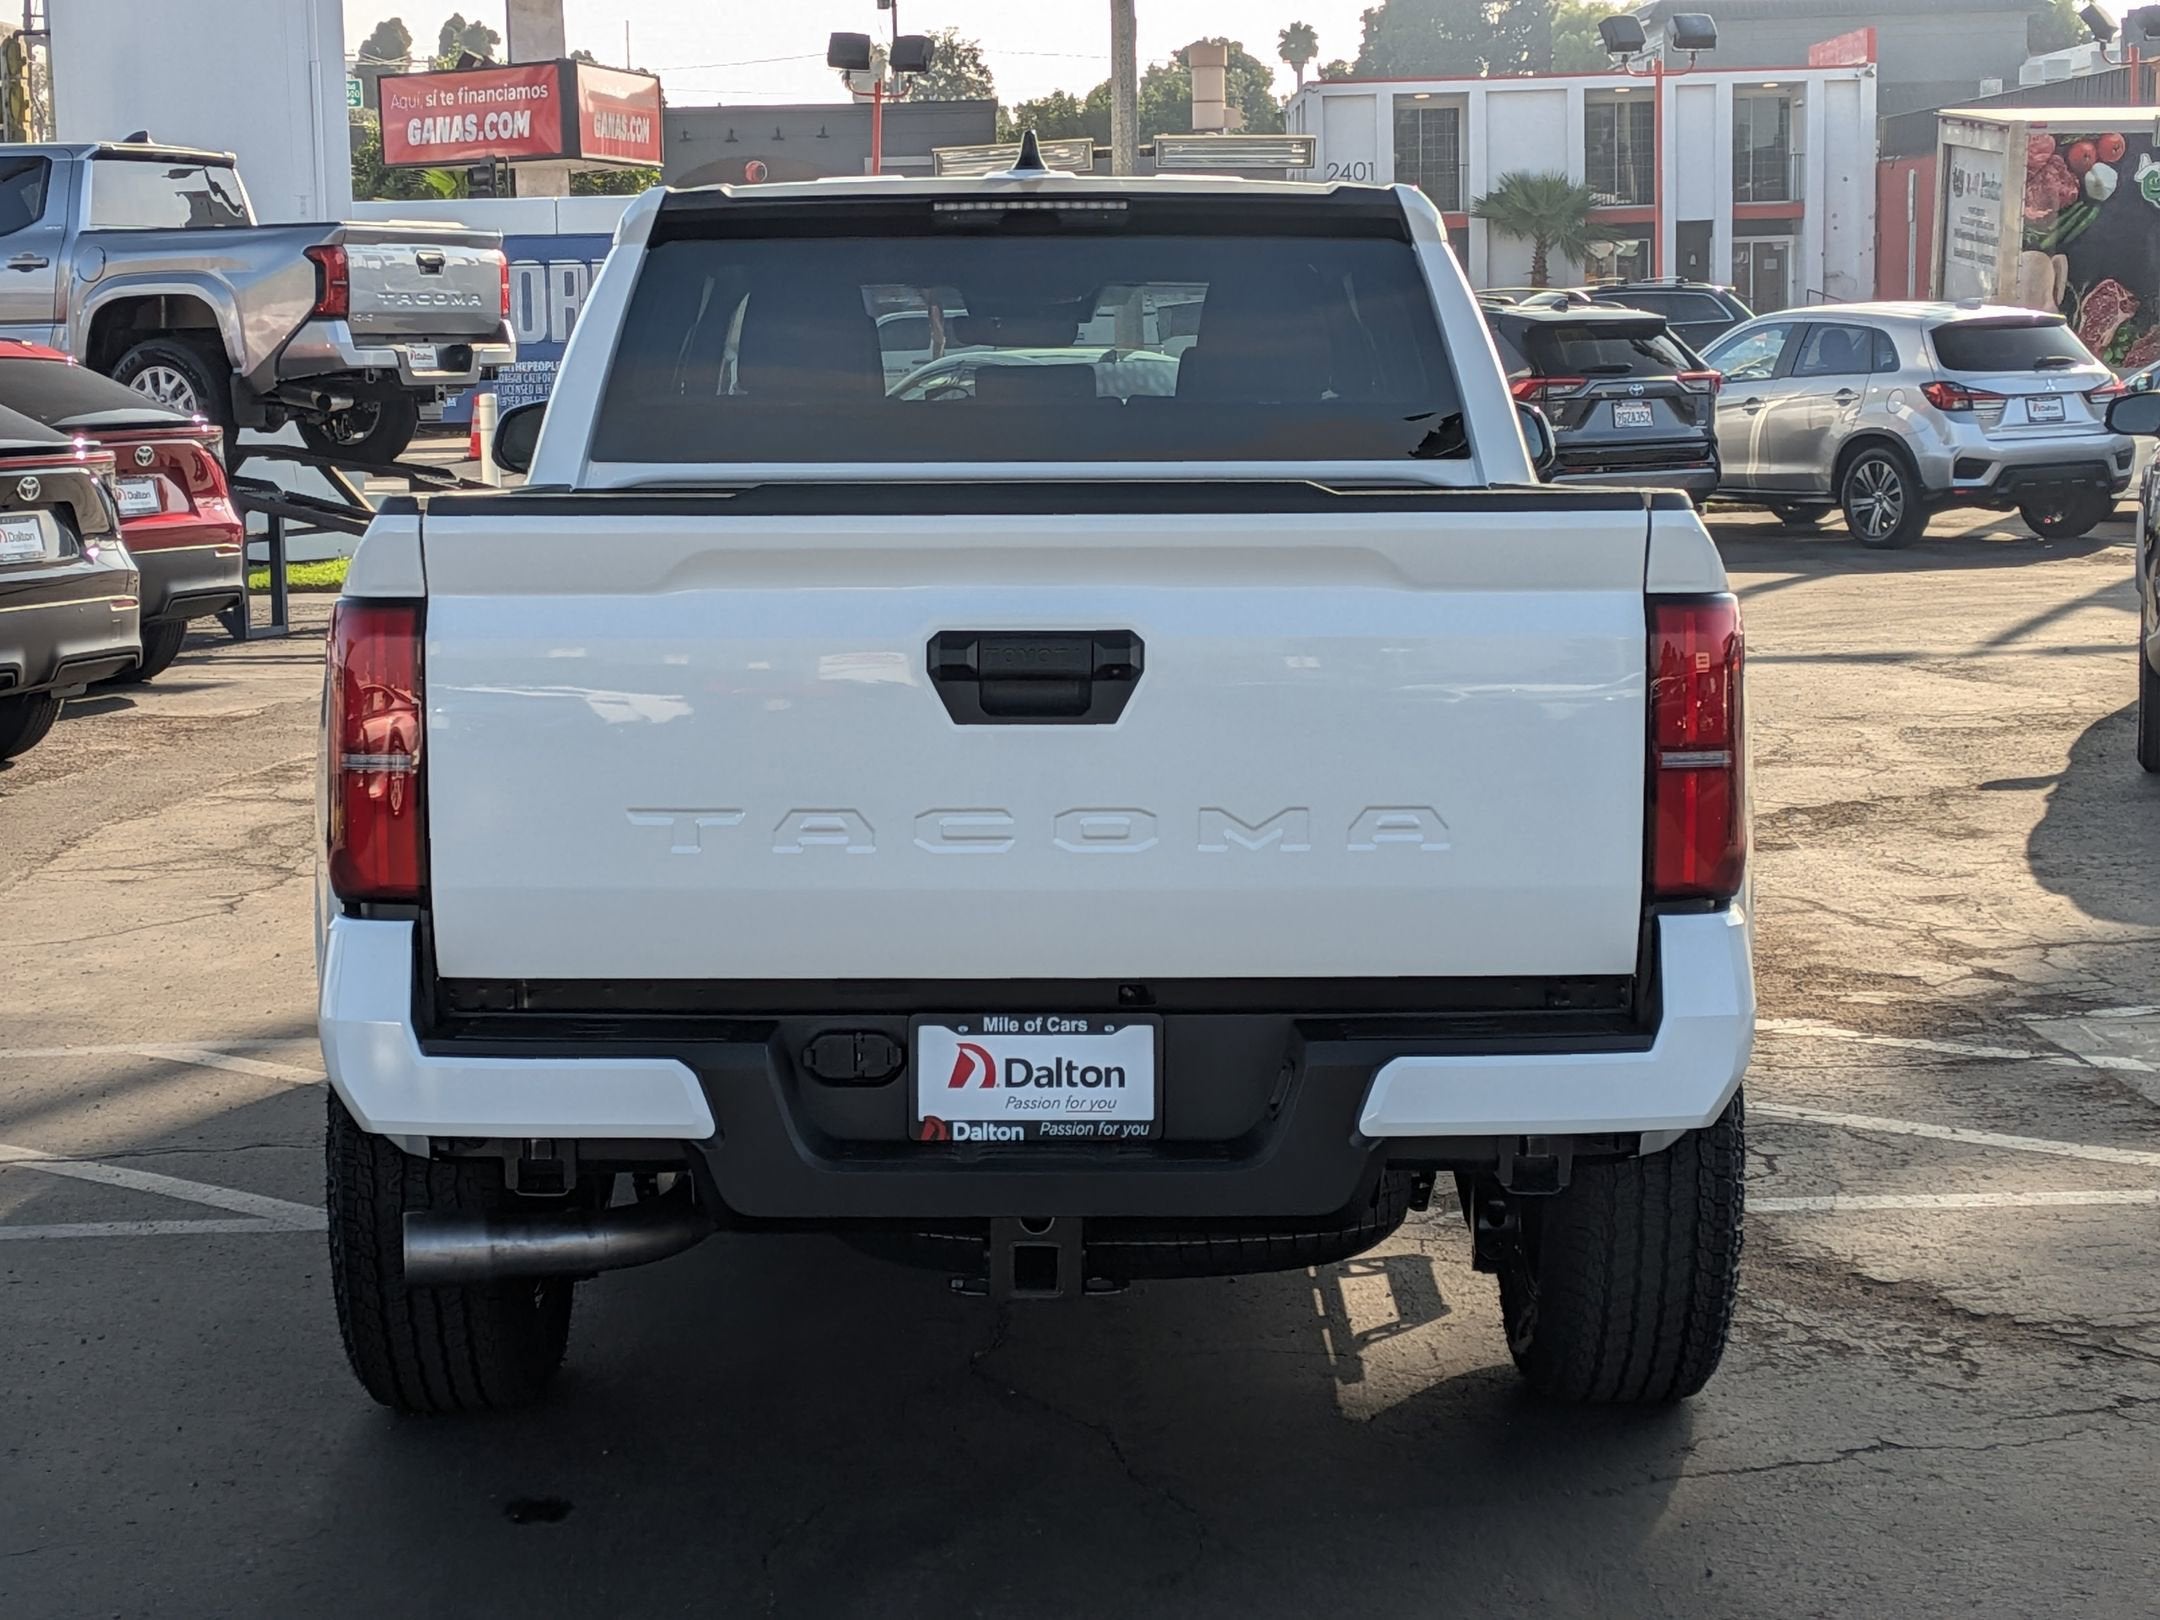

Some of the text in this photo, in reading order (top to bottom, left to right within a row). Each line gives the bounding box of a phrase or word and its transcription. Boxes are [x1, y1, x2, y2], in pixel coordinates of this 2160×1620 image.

[440, 91, 455, 106] te
[457, 83, 549, 105] financiamos
[407, 110, 531, 146] GANAS.COM
[593, 111, 650, 144] GANAS.COM
[1327, 161, 1374, 181] 2401
[376, 292, 482, 306] TACOMA
[127, 490, 151, 500] Dalton
[7, 530, 36, 542] Dalton
[626, 805, 1452, 855] TACOMA
[983, 1016, 1088, 1032] Mile of Cars
[1004, 1057, 1126, 1088] Dalton
[1005, 1095, 1117, 1111] Passion for you
[953, 1121, 1150, 1141] Dalton Passion for you
